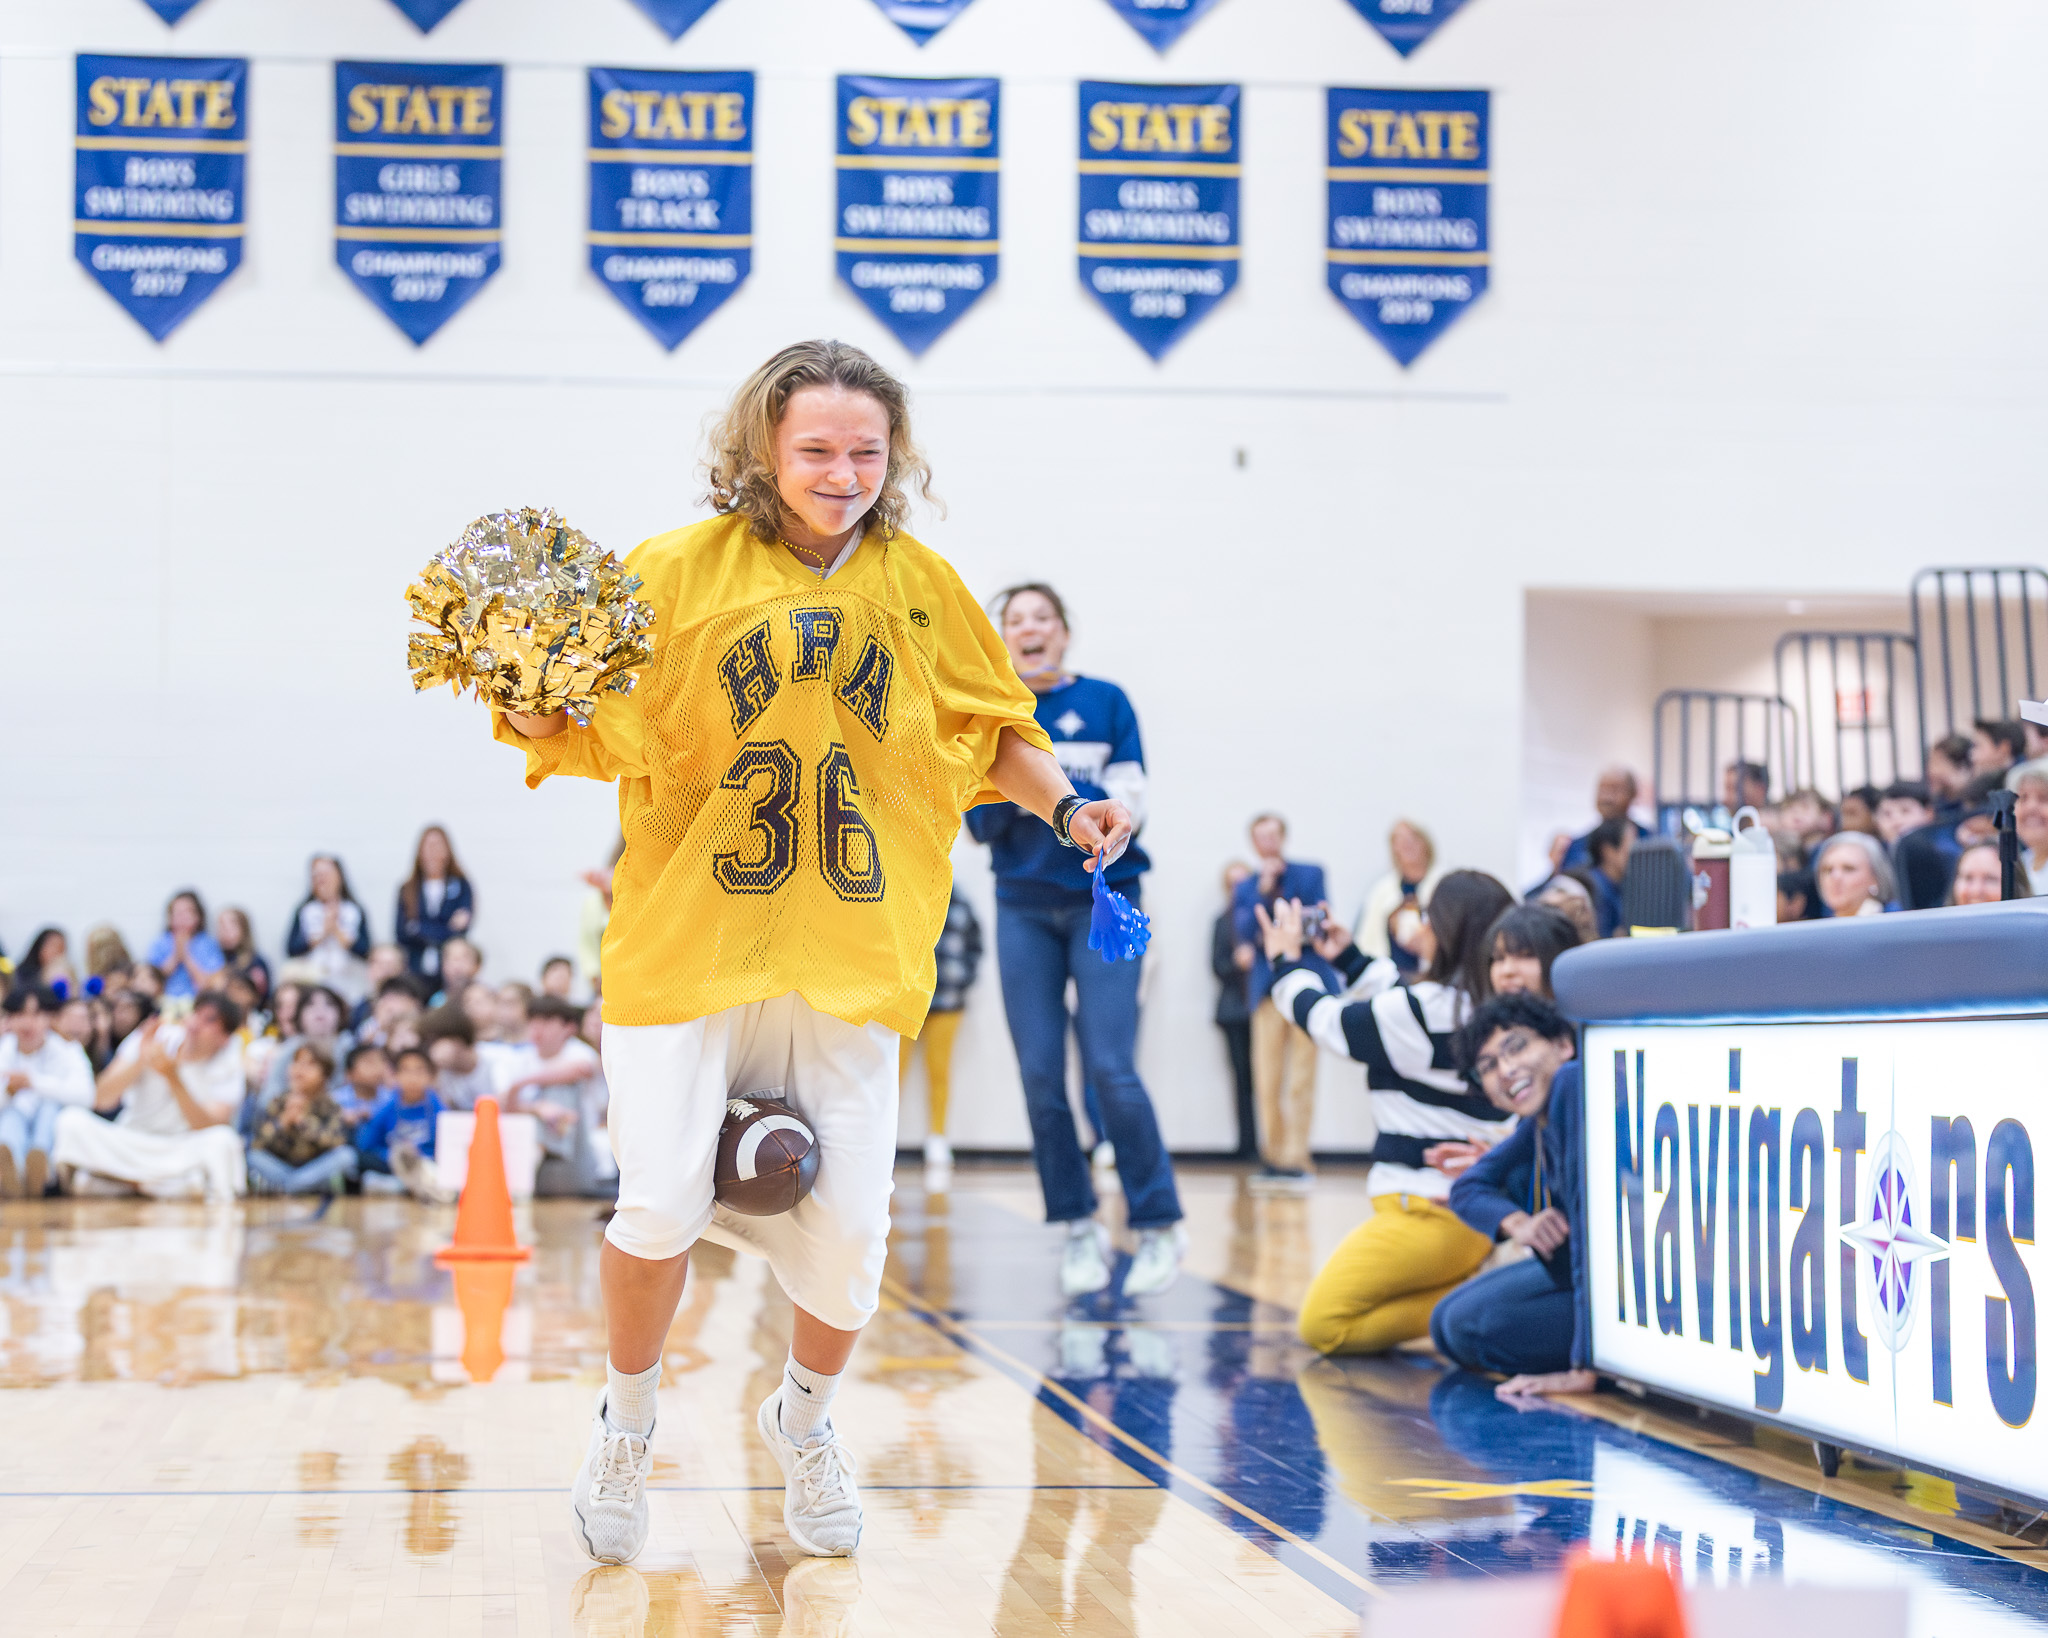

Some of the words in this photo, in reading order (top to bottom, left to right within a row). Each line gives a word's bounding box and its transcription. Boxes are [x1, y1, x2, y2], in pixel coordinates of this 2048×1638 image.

[88, 76, 236, 129] STATE
[348, 83, 494, 135] STATE
[601, 89, 746, 141] STATE
[847, 96, 992, 148] STATE
[1088, 101, 1232, 153] STATE
[1337, 108, 1479, 160] STATE
[125, 157, 195, 188] BOYS
[378, 163, 461, 193] GIRLS
[631, 168, 709, 199] BOYS
[84, 186, 234, 220] SWIMMING
[883, 175, 954, 204] BOYS
[1118, 180, 1199, 211] GIRLS
[1373, 187, 1442, 216] BOYS
[345, 192, 493, 225] SWIMMING
[616, 198, 720, 230] TRACK
[844, 203, 989, 237] SWIMMING
[1085, 209, 1229, 242] SWIMMING
[1334, 215, 1477, 248] SWIMMING
[92, 244, 227, 274] CHAMPIONS
[352, 250, 486, 279] CHAMPIONS
[603, 255, 737, 284] CHAMPIONS
[131, 271, 188, 297] 2017
[391, 275, 448, 302] 2017
[852, 261, 984, 290] CHAMPIONS
[1092, 266, 1223, 295] CHAMPIONS
[1340, 273, 1472, 301] CHAMPIONS
[641, 280, 699, 307] 2017
[713, 738, 886, 903] 36
